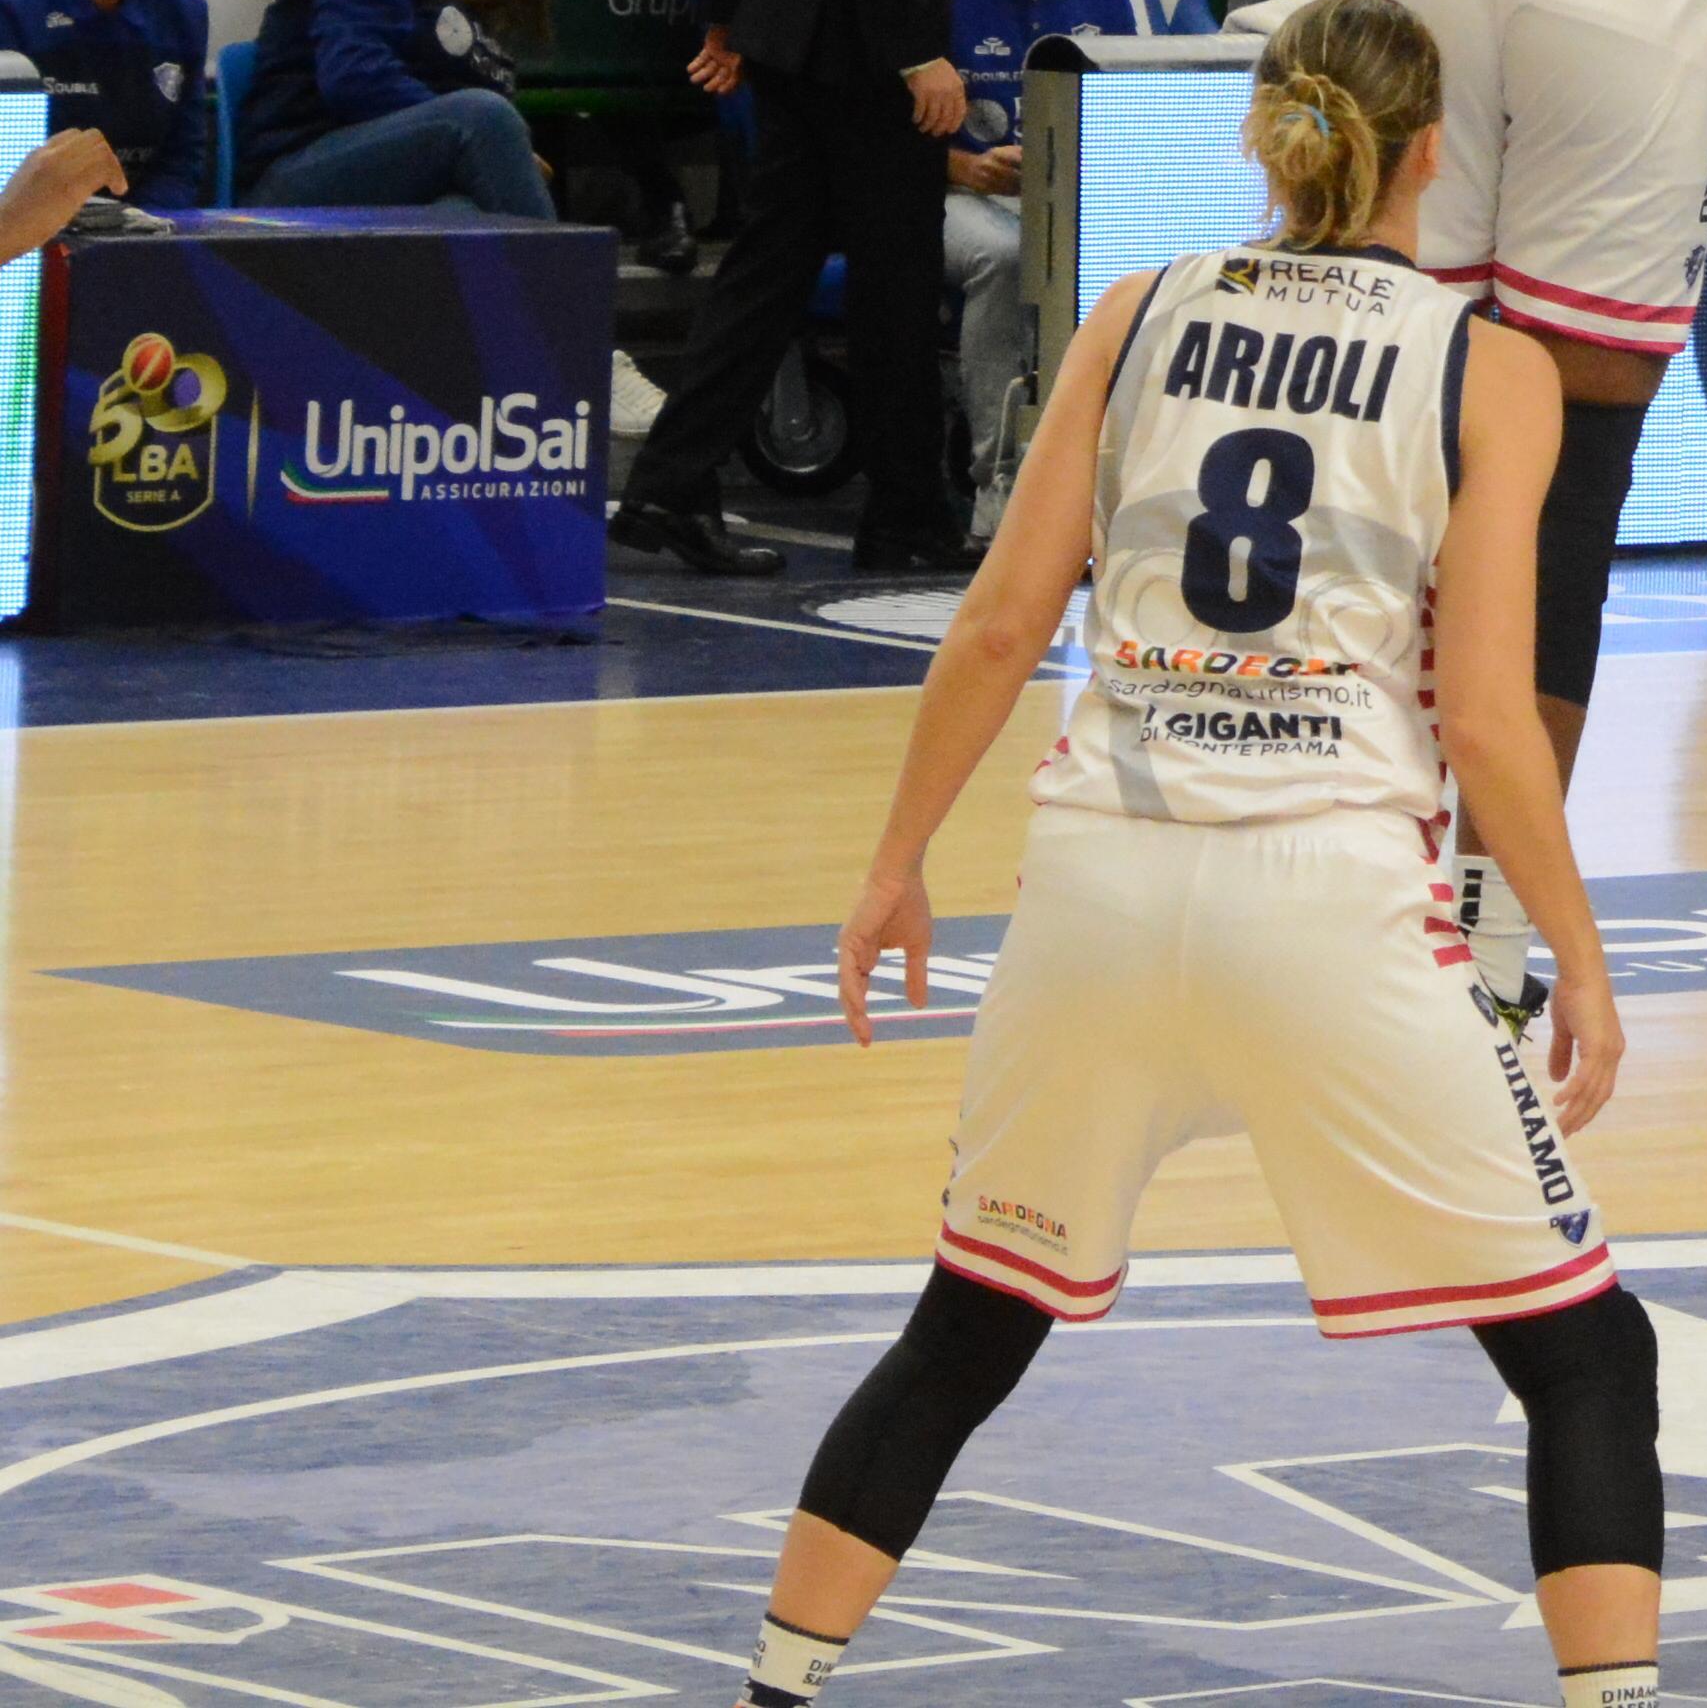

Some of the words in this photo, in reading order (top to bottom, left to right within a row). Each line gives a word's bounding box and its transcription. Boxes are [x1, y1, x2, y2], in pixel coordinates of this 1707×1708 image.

[1270, 260, 1395, 300] REALE
[1267, 285, 1386, 316] MUTUA
[1164, 320, 1402, 424] ARIOLI
[112, 443, 199, 483] LBA
[305, 392, 590, 501] UnipolSai
[126, 491, 170, 504] SERIE
[173, 491, 182, 503] A
[420, 480, 586, 501] ASSICURAZIONI
[1180, 427, 1316, 634] 8
[1165, 711, 1343, 742] GIGANTI
[1260, 742, 1340, 759] PRAMA
[1494, 1041, 1575, 1206] DINAMO
[977, 1194, 1068, 1241] SARDEGNA
